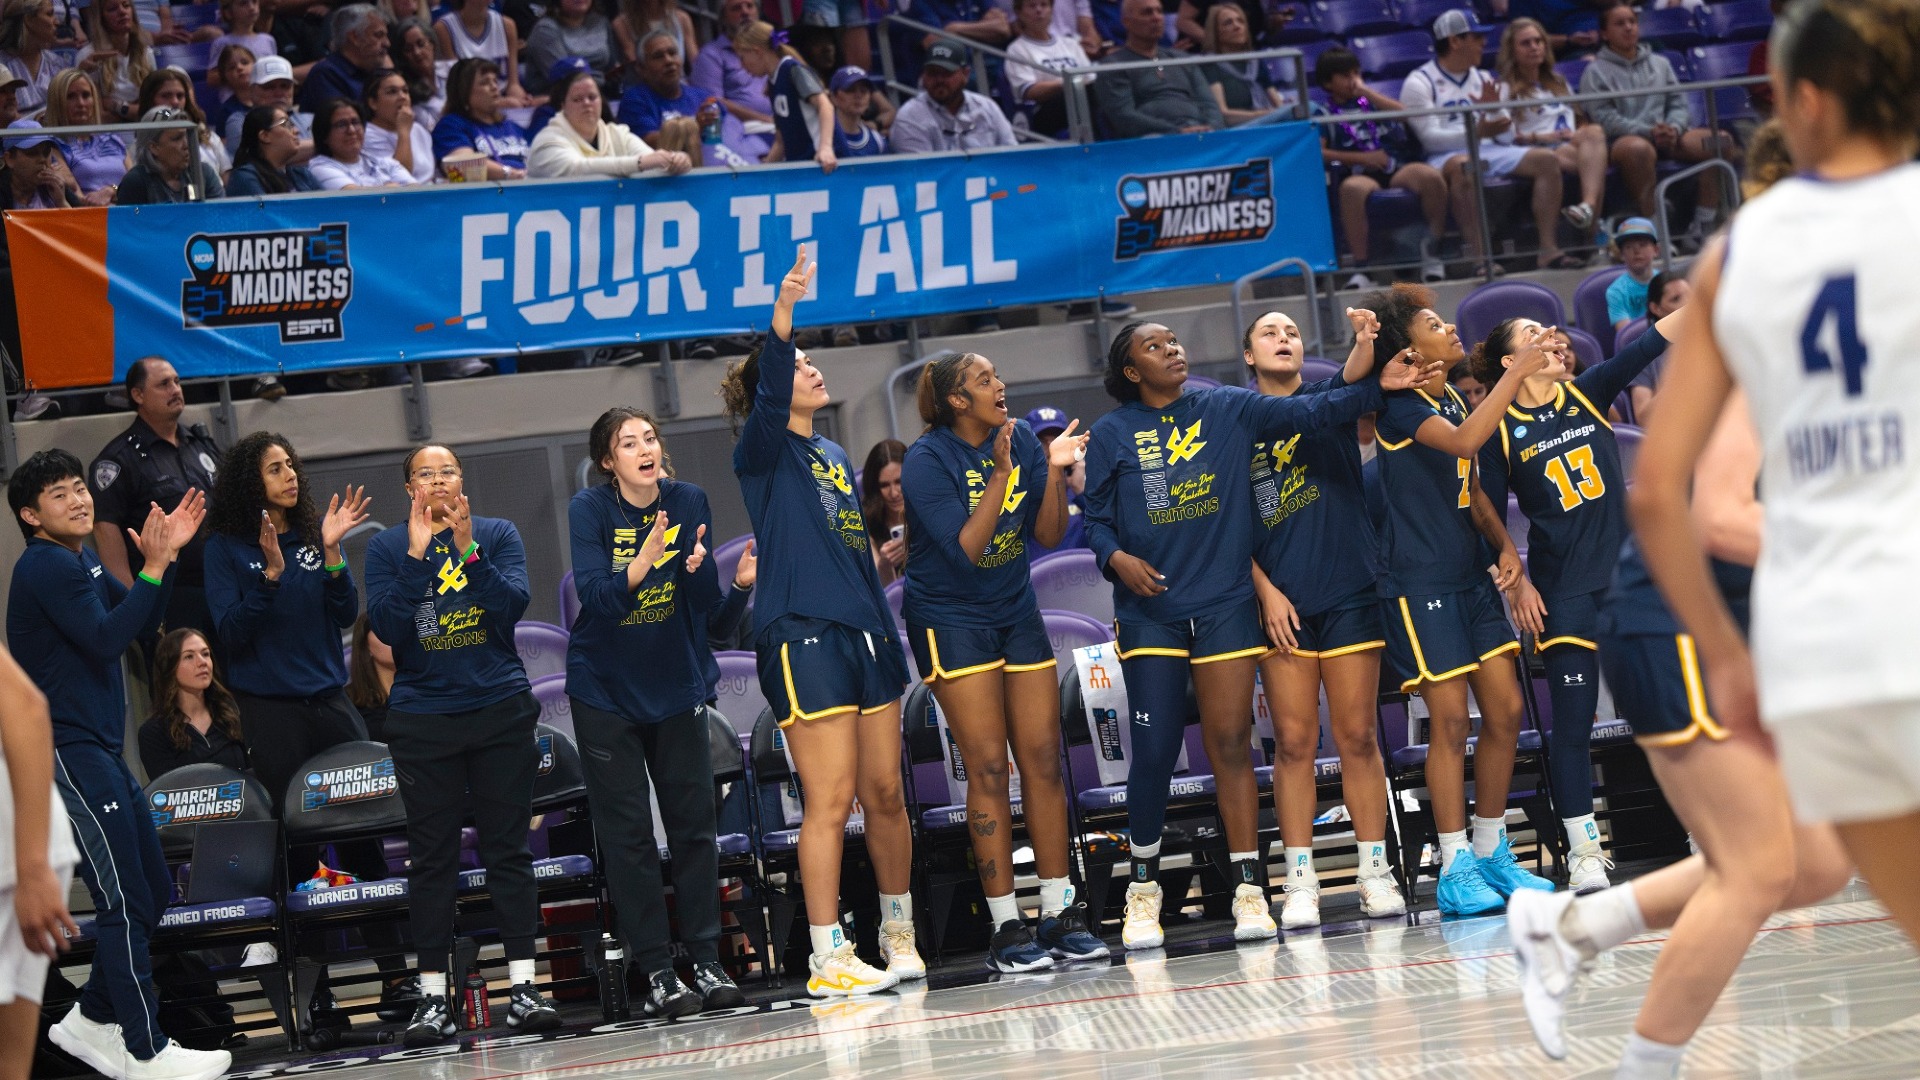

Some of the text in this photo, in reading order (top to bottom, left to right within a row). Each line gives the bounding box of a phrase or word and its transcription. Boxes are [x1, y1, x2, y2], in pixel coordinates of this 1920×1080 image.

[1147, 172, 1231, 210] MARCH
[1159, 198, 1272, 239] MADNESS
[217, 236, 303, 273] MARCH
[461, 177, 1018, 330] FOUR IT ALL
[231, 267, 349, 306] MADNESS
[287, 318, 335, 336] ESPN
[1801, 272, 1868, 396] 4
[1134, 428, 1170, 510] UC SAN DIEGO
[1544, 443, 1606, 512] 13
[1147, 497, 1219, 525] TRITONS
[1263, 485, 1321, 531] TRITONS
[613, 528, 637, 545] UC
[978, 540, 1024, 568] RITONS
[420, 629, 487, 652] TRITONS
[1099, 723, 1115, 761] MADNESS
[1107, 718, 1120, 747] MARCH
[322, 765, 372, 786] MARCH
[330, 775, 397, 799] MADNESS
[1170, 782, 1204, 796] ROGS
[167, 787, 218, 806] MARCH
[174, 798, 242, 819] MADNESS
[533, 863, 564, 878] ROGS
[307, 883, 403, 906] HORNED FROGS
[157, 904, 246, 927] ORNED FROGS
